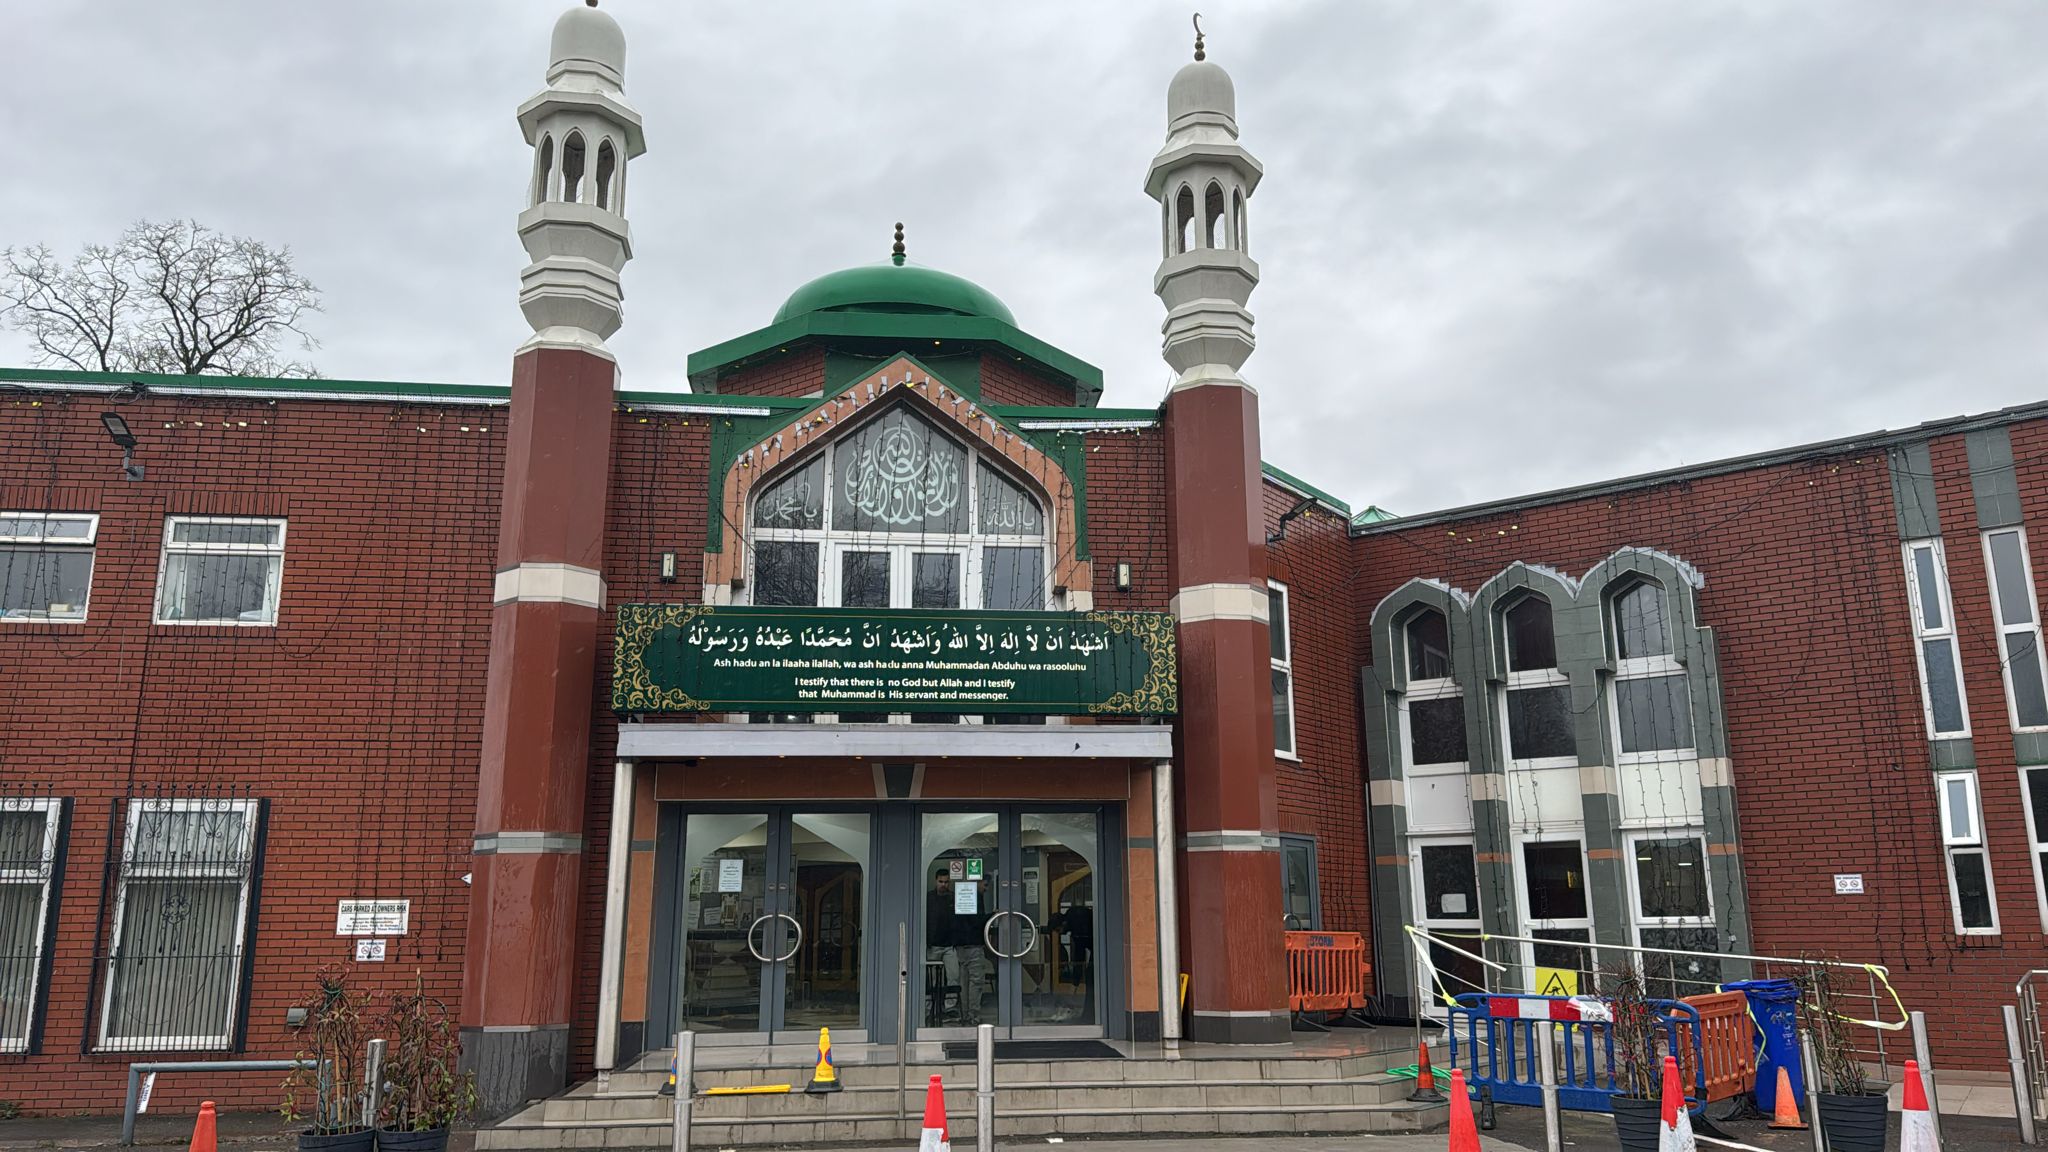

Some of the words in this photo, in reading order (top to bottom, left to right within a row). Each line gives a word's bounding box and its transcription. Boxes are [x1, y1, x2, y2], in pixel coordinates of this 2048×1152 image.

[714, 659, 731, 667] Ash
[733, 659, 757, 668] hadu
[772, 659, 781, 668] la
[782, 659, 810, 668] ilaaha
[858, 660, 875, 669] ash
[876, 660, 900, 669] hadu
[926, 660, 990, 670] Muhammadan
[992, 661, 1027, 671] Abduhu
[1043, 662, 1087, 671] rasooluhu
[800, 677, 829, 688] testify
[830, 678, 849, 687] that
[850, 678, 875, 687] there
[876, 678, 884, 687] is
[888, 679, 901, 687] no
[902, 678, 921, 687] God
[922, 678, 938, 688] but
[940, 678, 963, 688] Allah
[965, 679, 982, 688] and
[988, 679, 1016, 690] testify
[799, 690, 818, 699] that
[822, 690, 877, 699] Muhammad
[878, 690, 886, 699] is
[889, 690, 904, 699] His
[905, 691, 938, 699] servant
[940, 690, 957, 699] and
[958, 692, 1009, 702] messenger.
[341, 905, 352, 913] CARS
[354, 905, 371, 913] PARKED
[397, 904, 407, 912] RISK
[1309, 936, 1334, 947] STORM
